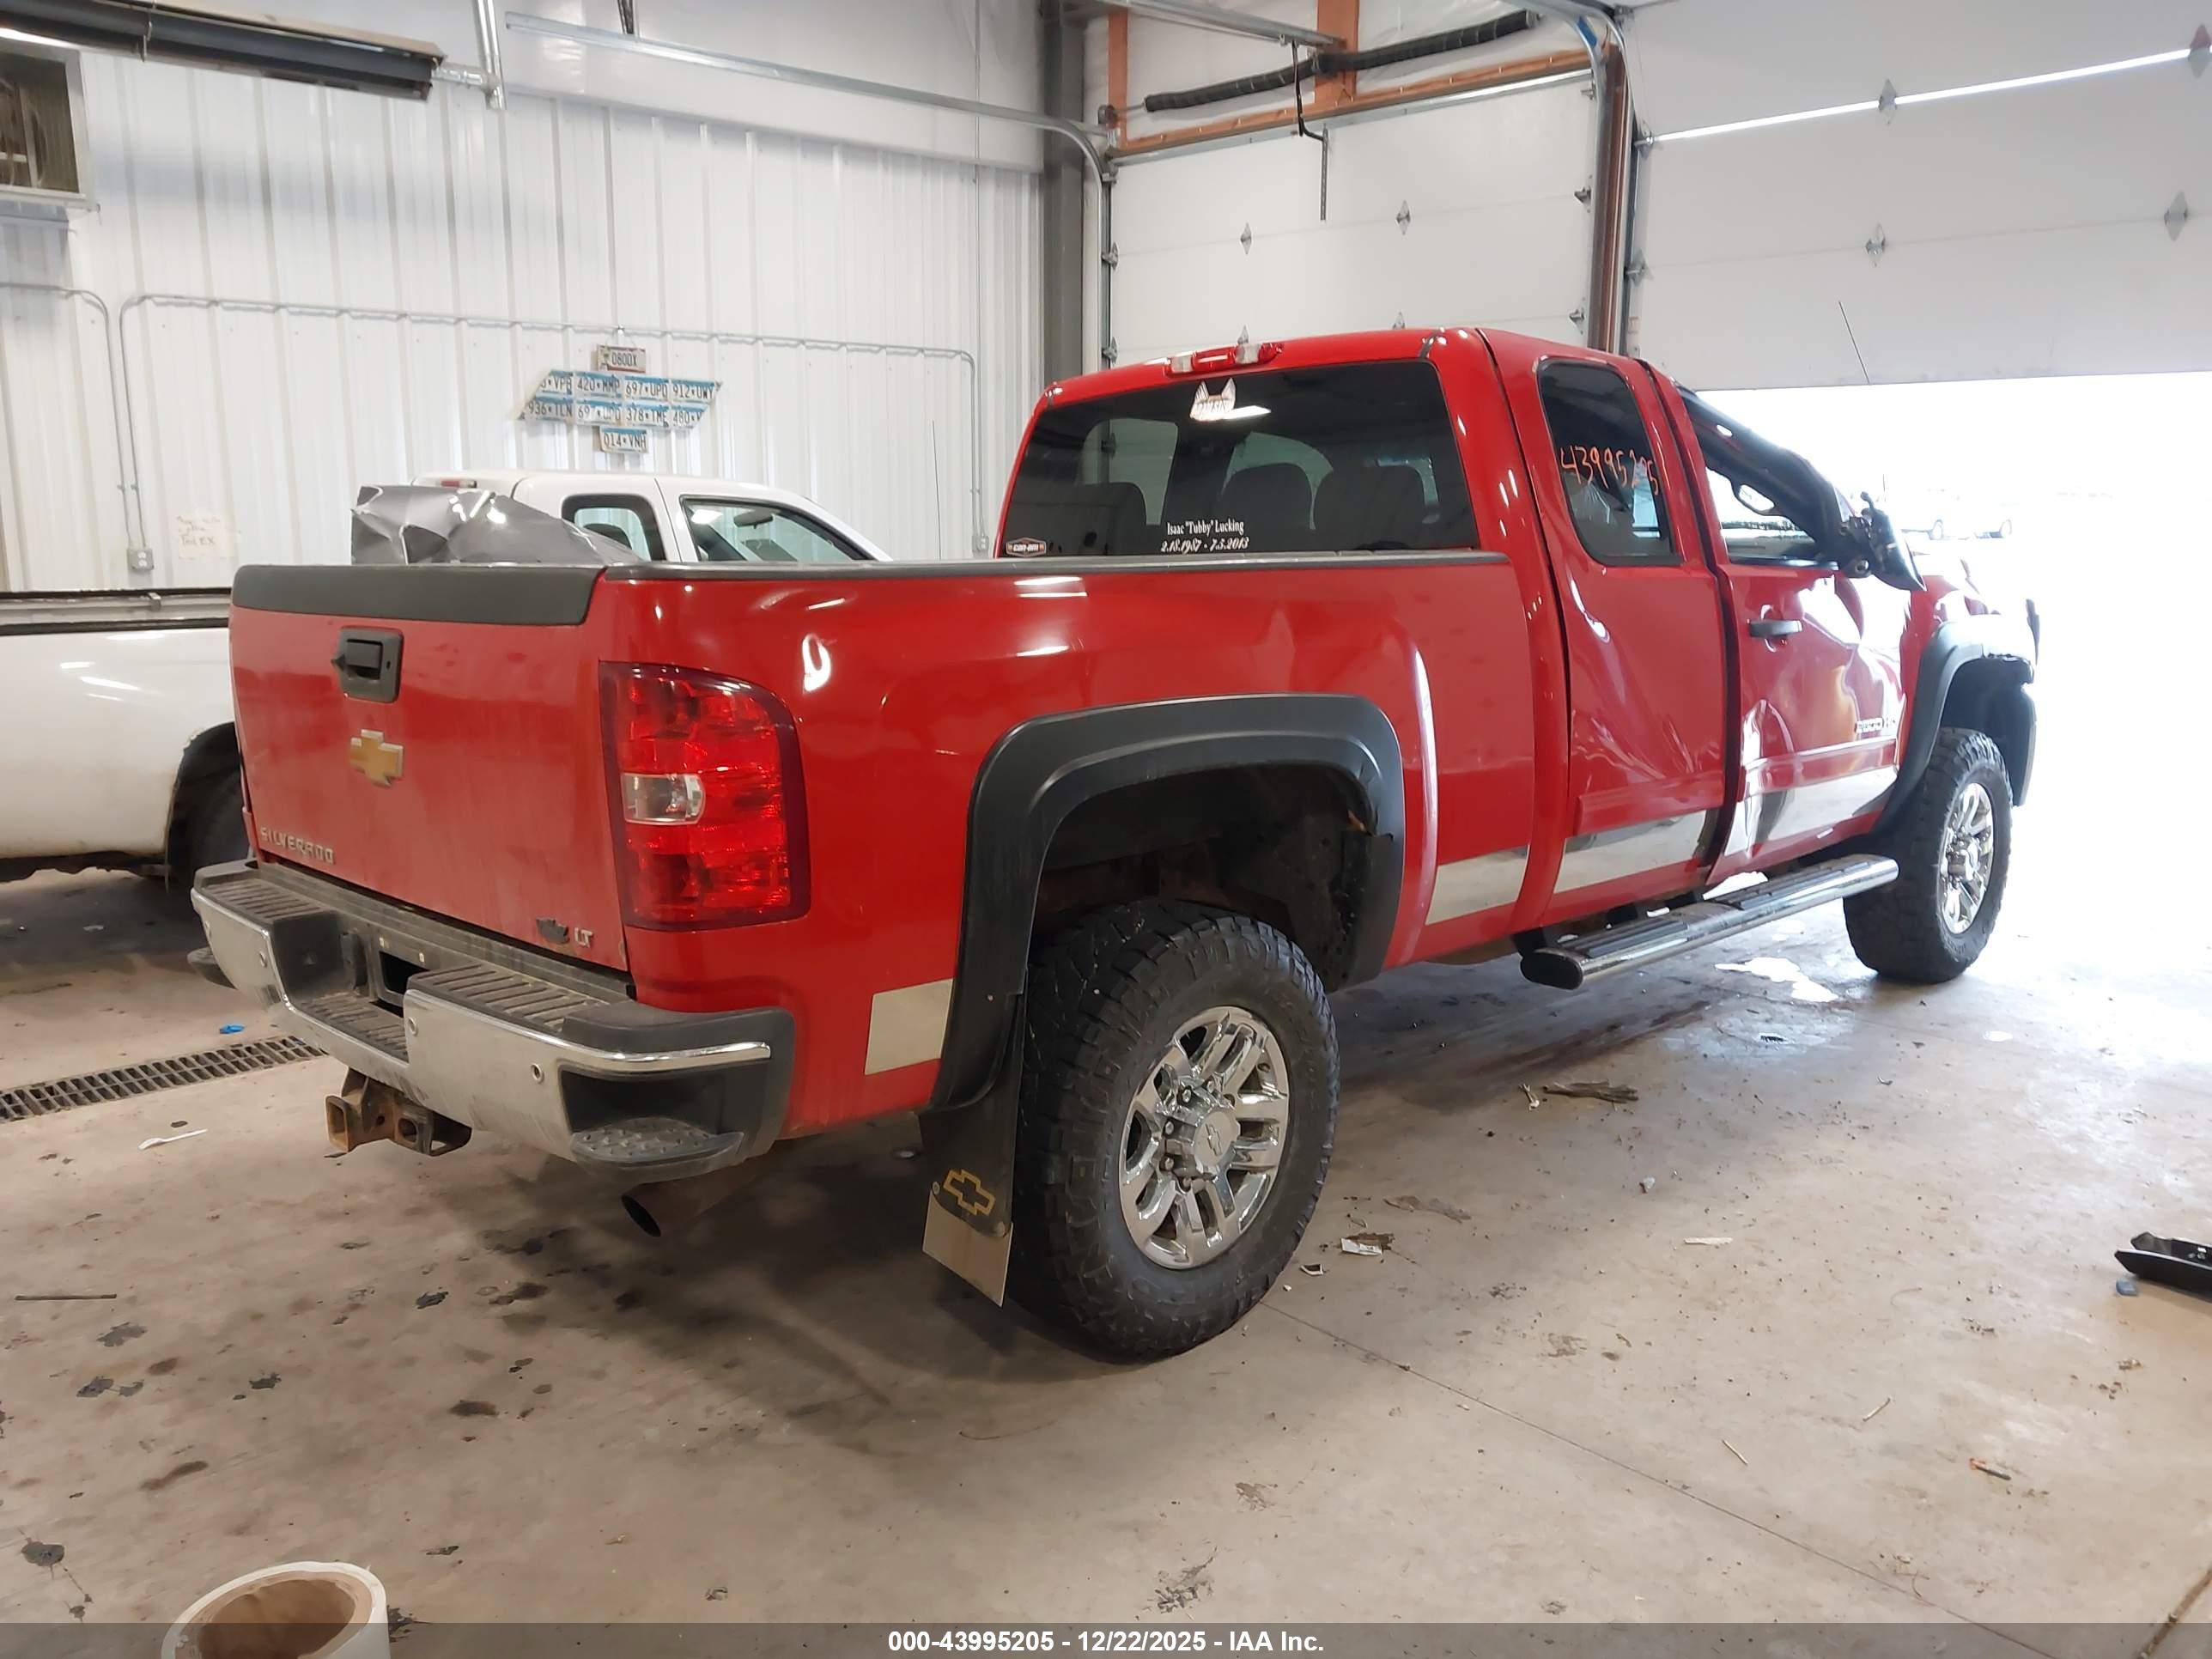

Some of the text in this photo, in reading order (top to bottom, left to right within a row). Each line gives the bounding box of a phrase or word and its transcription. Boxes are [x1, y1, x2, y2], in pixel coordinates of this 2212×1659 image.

[1167, 522, 1185, 536] Isaac
[1215, 517, 1244, 536] Lucking
[260, 826, 334, 866] SILVERADO
[574, 927, 593, 948] LT
